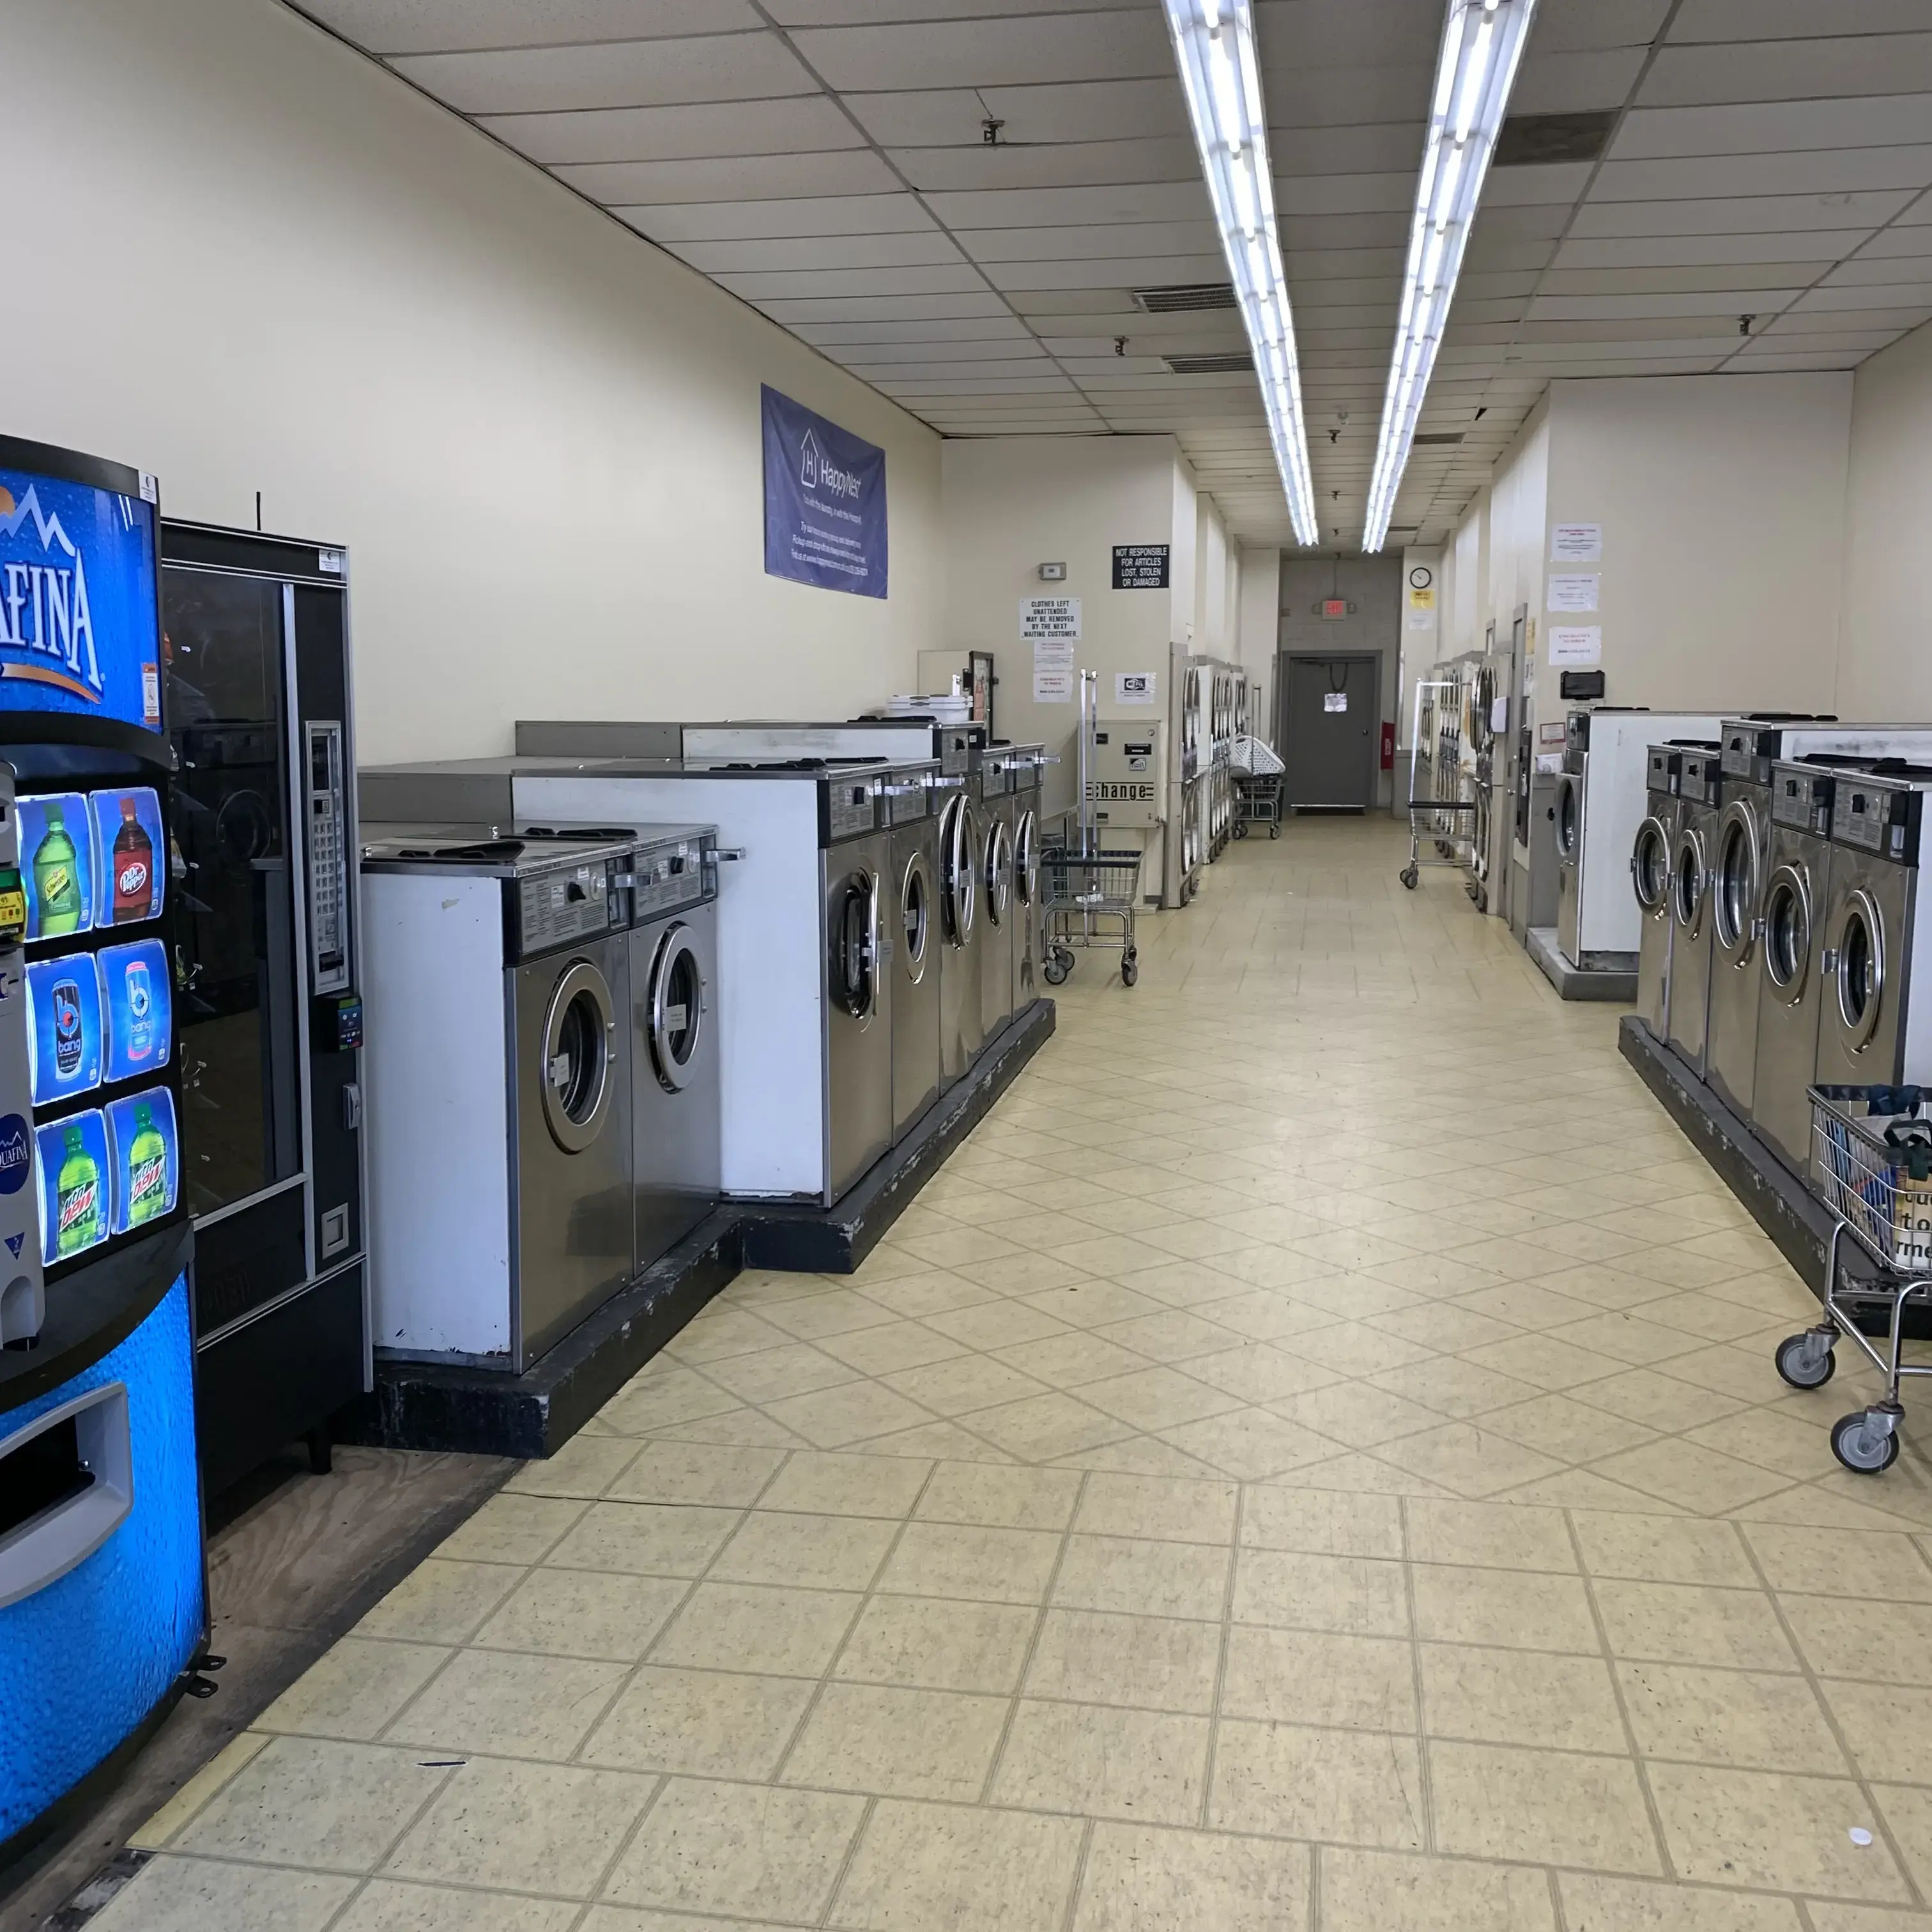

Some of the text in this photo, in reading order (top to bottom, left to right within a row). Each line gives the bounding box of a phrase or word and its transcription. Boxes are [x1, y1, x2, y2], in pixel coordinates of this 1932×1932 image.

[821, 458, 861, 499] HappyNest
[1116, 547, 1167, 556] NOT RESPONSIBLE
[1121, 557, 1162, 567] FOR ARTICLES
[1121, 567, 1162, 578] LOST, STOLEN
[1123, 578, 1160, 587] OR DAMAGED
[129, 866, 139, 880] Dr
[123, 870, 144, 893] Pepper
[131, 1020, 151, 1034] bang
[58, 1038, 81, 1054] bang
